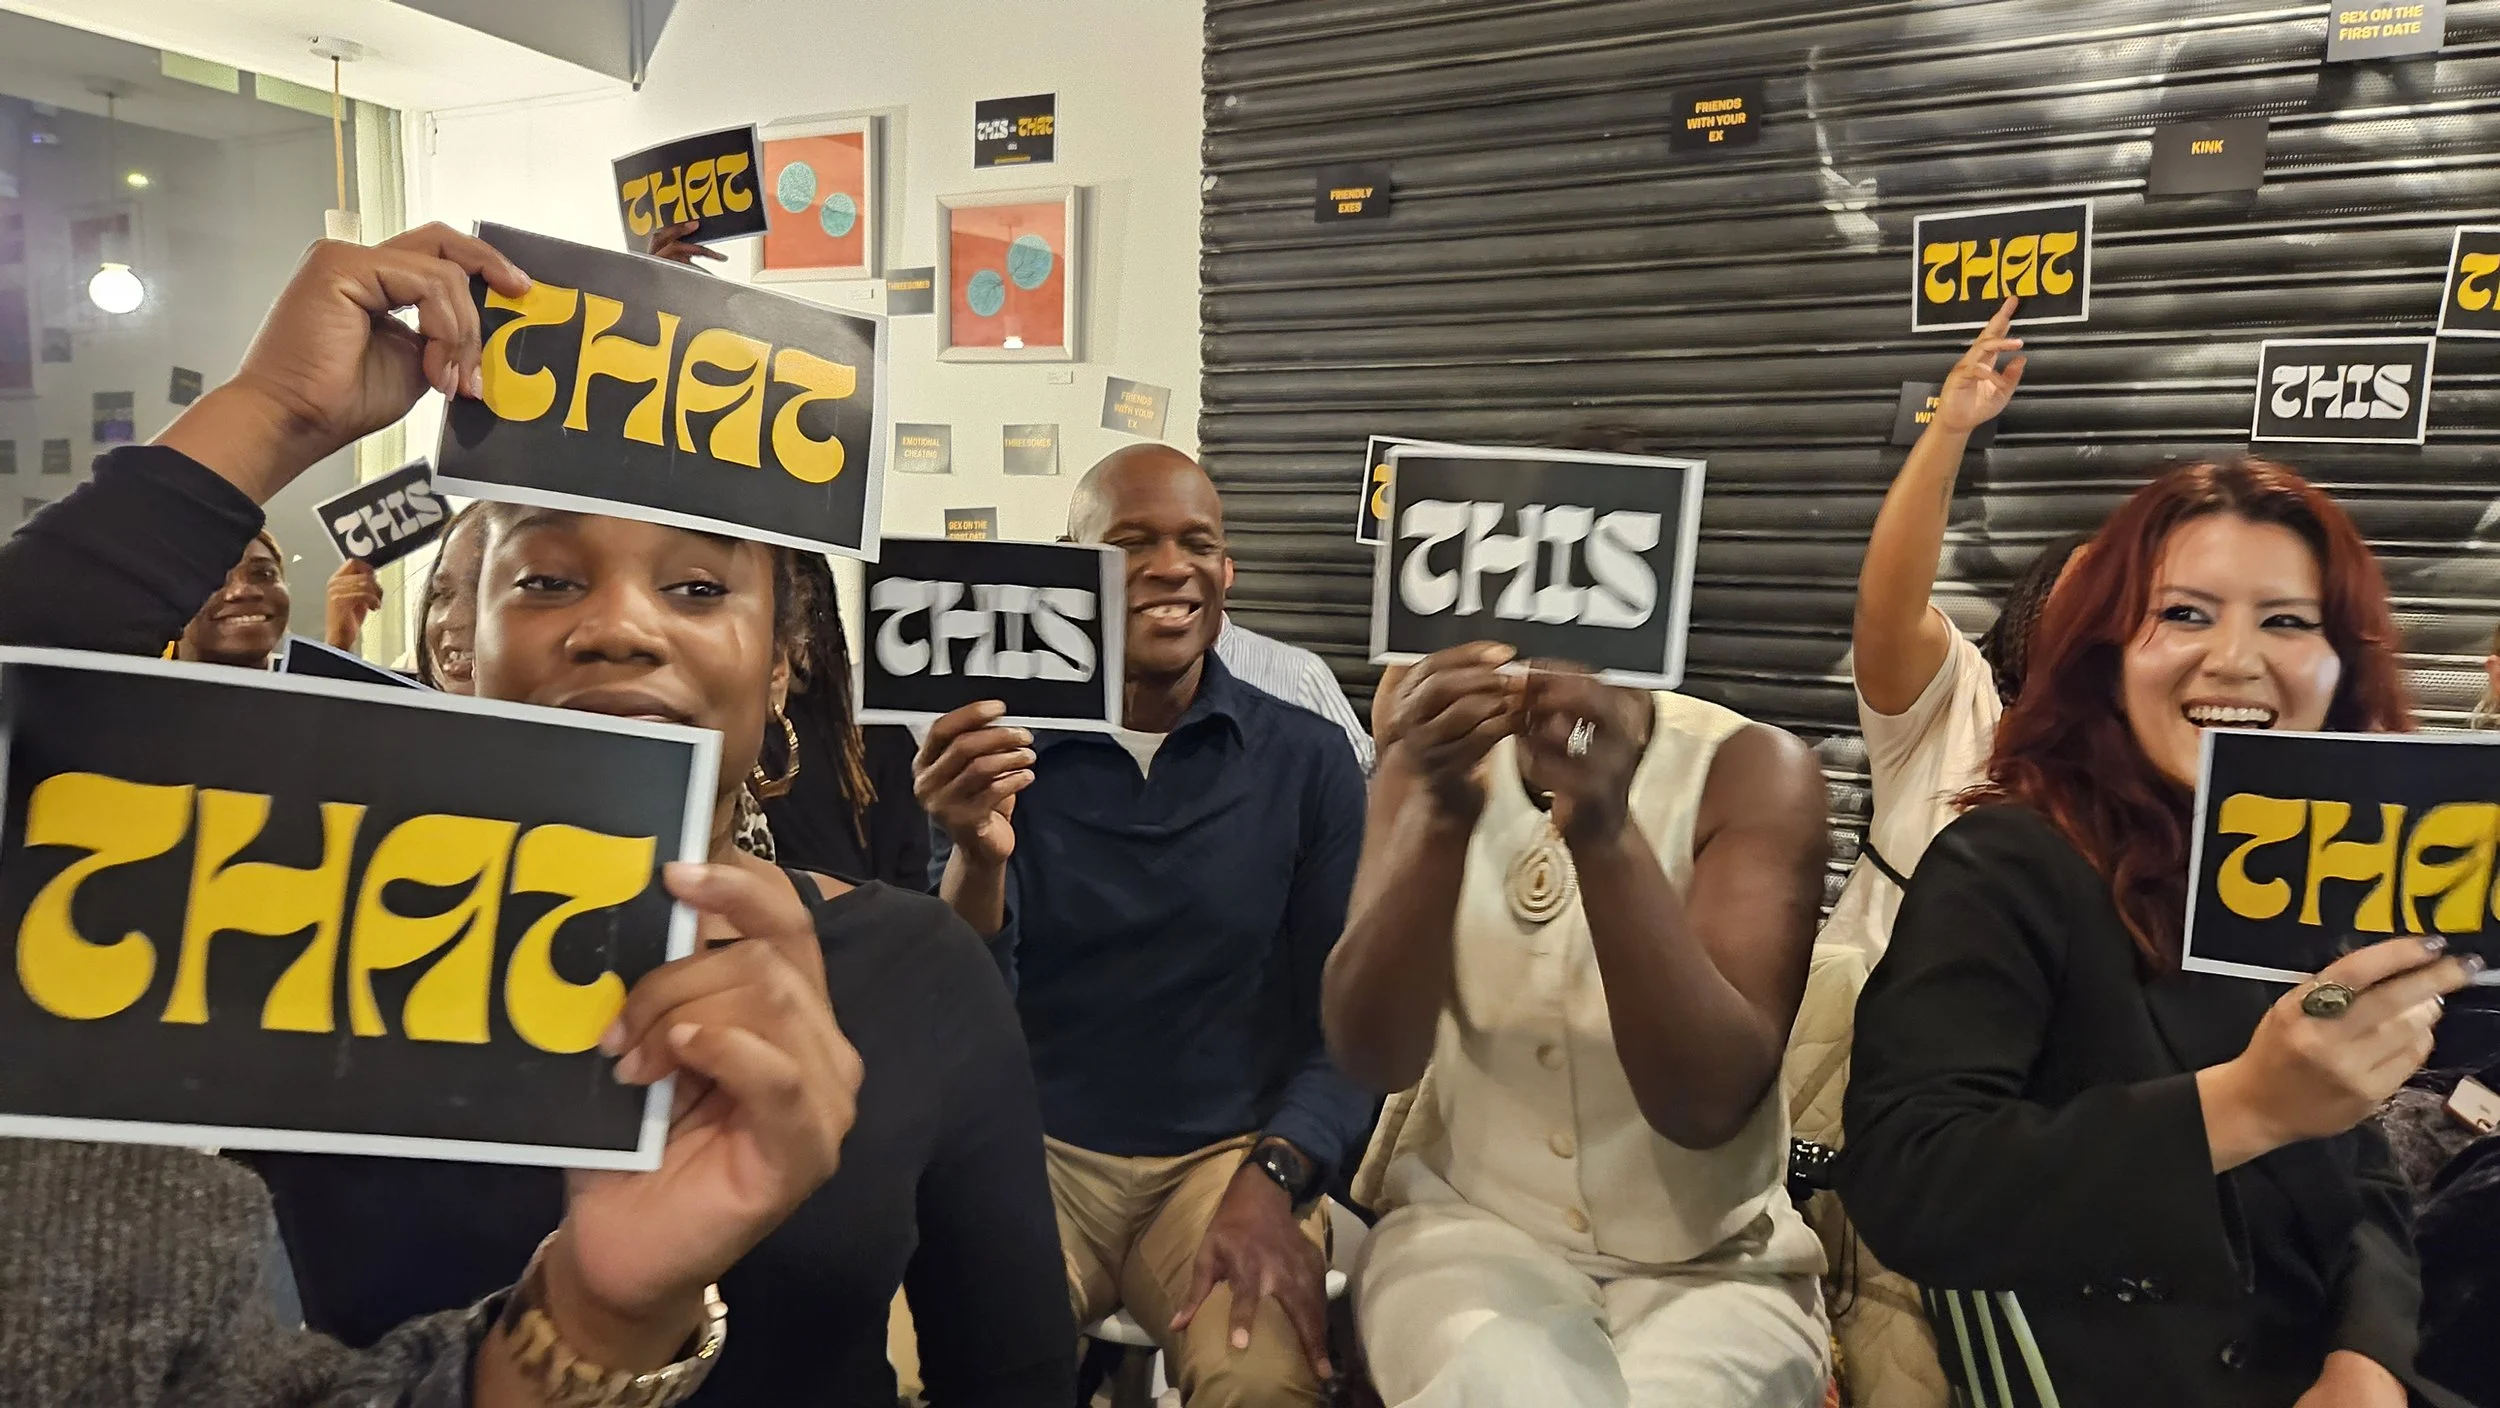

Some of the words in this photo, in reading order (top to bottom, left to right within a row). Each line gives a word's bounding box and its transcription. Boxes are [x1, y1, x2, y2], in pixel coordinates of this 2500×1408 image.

[2339, 10, 2369, 24] SEX
[2370, 7, 2393, 21] ON
[2394, 4, 2425, 18] THE
[2339, 25, 2381, 41] FIRST
[2382, 21, 2422, 37] DATE
[1687, 116, 1716, 130] WITH
[1716, 112, 1747, 126] YOUR
[1695, 97, 1742, 114] FRIENDS
[977, 120, 1009, 141] THIS
[1018, 116, 1054, 137] THAT
[1708, 130, 1724, 142] EX
[2191, 140, 2225, 155] KINK
[622, 151, 753, 236] THAT
[1330, 187, 1374, 200] FRIENDLY
[1338, 201, 1363, 213] EXES
[1923, 231, 2078, 304] THAT
[481, 280, 857, 483] THAT
[2271, 364, 2413, 419] THIS
[333, 479, 443, 557] THIS
[1399, 499, 1662, 629] THIS
[870, 576, 1097, 683] THIS
[2217, 793, 2500, 934] THA
[16, 771, 657, 1054] THAT
